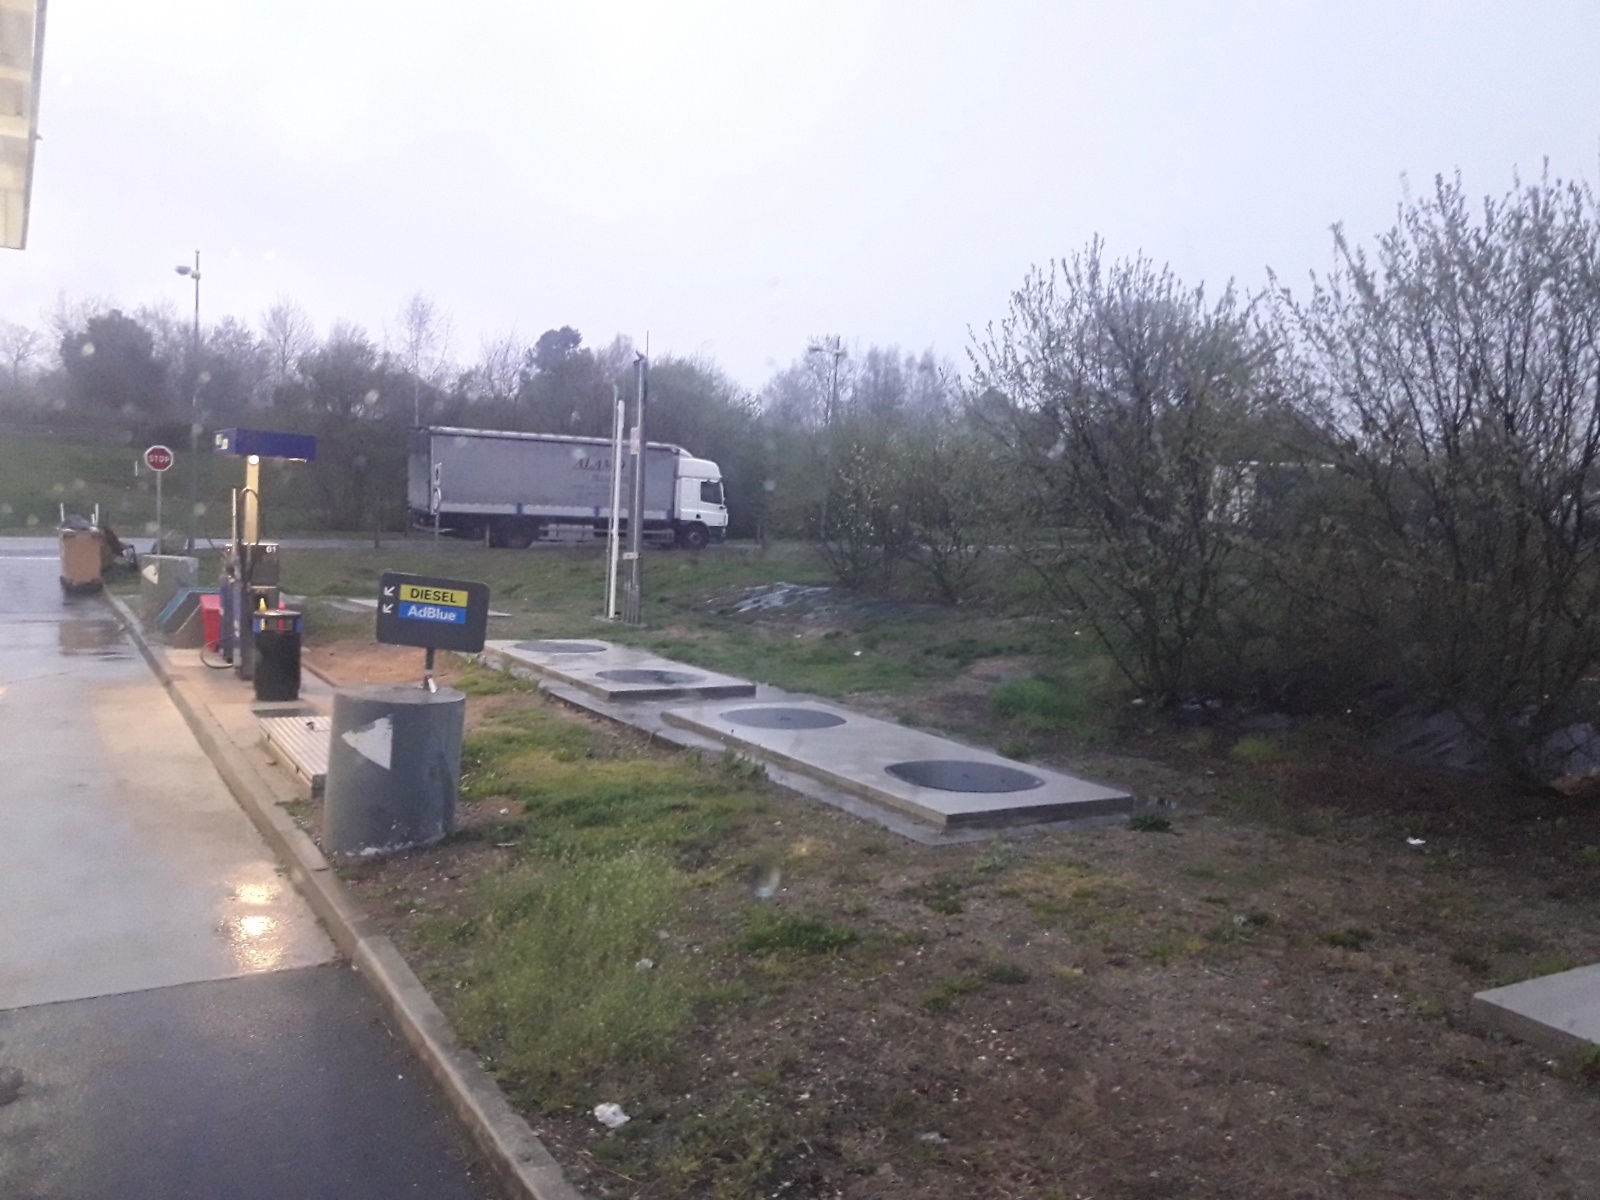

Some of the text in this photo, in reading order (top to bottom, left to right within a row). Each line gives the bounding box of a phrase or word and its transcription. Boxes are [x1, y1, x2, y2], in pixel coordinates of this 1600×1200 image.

[148, 454, 170, 463] STOP
[410, 588, 457, 603] DIESEL
[407, 605, 457, 621] AdBlue
